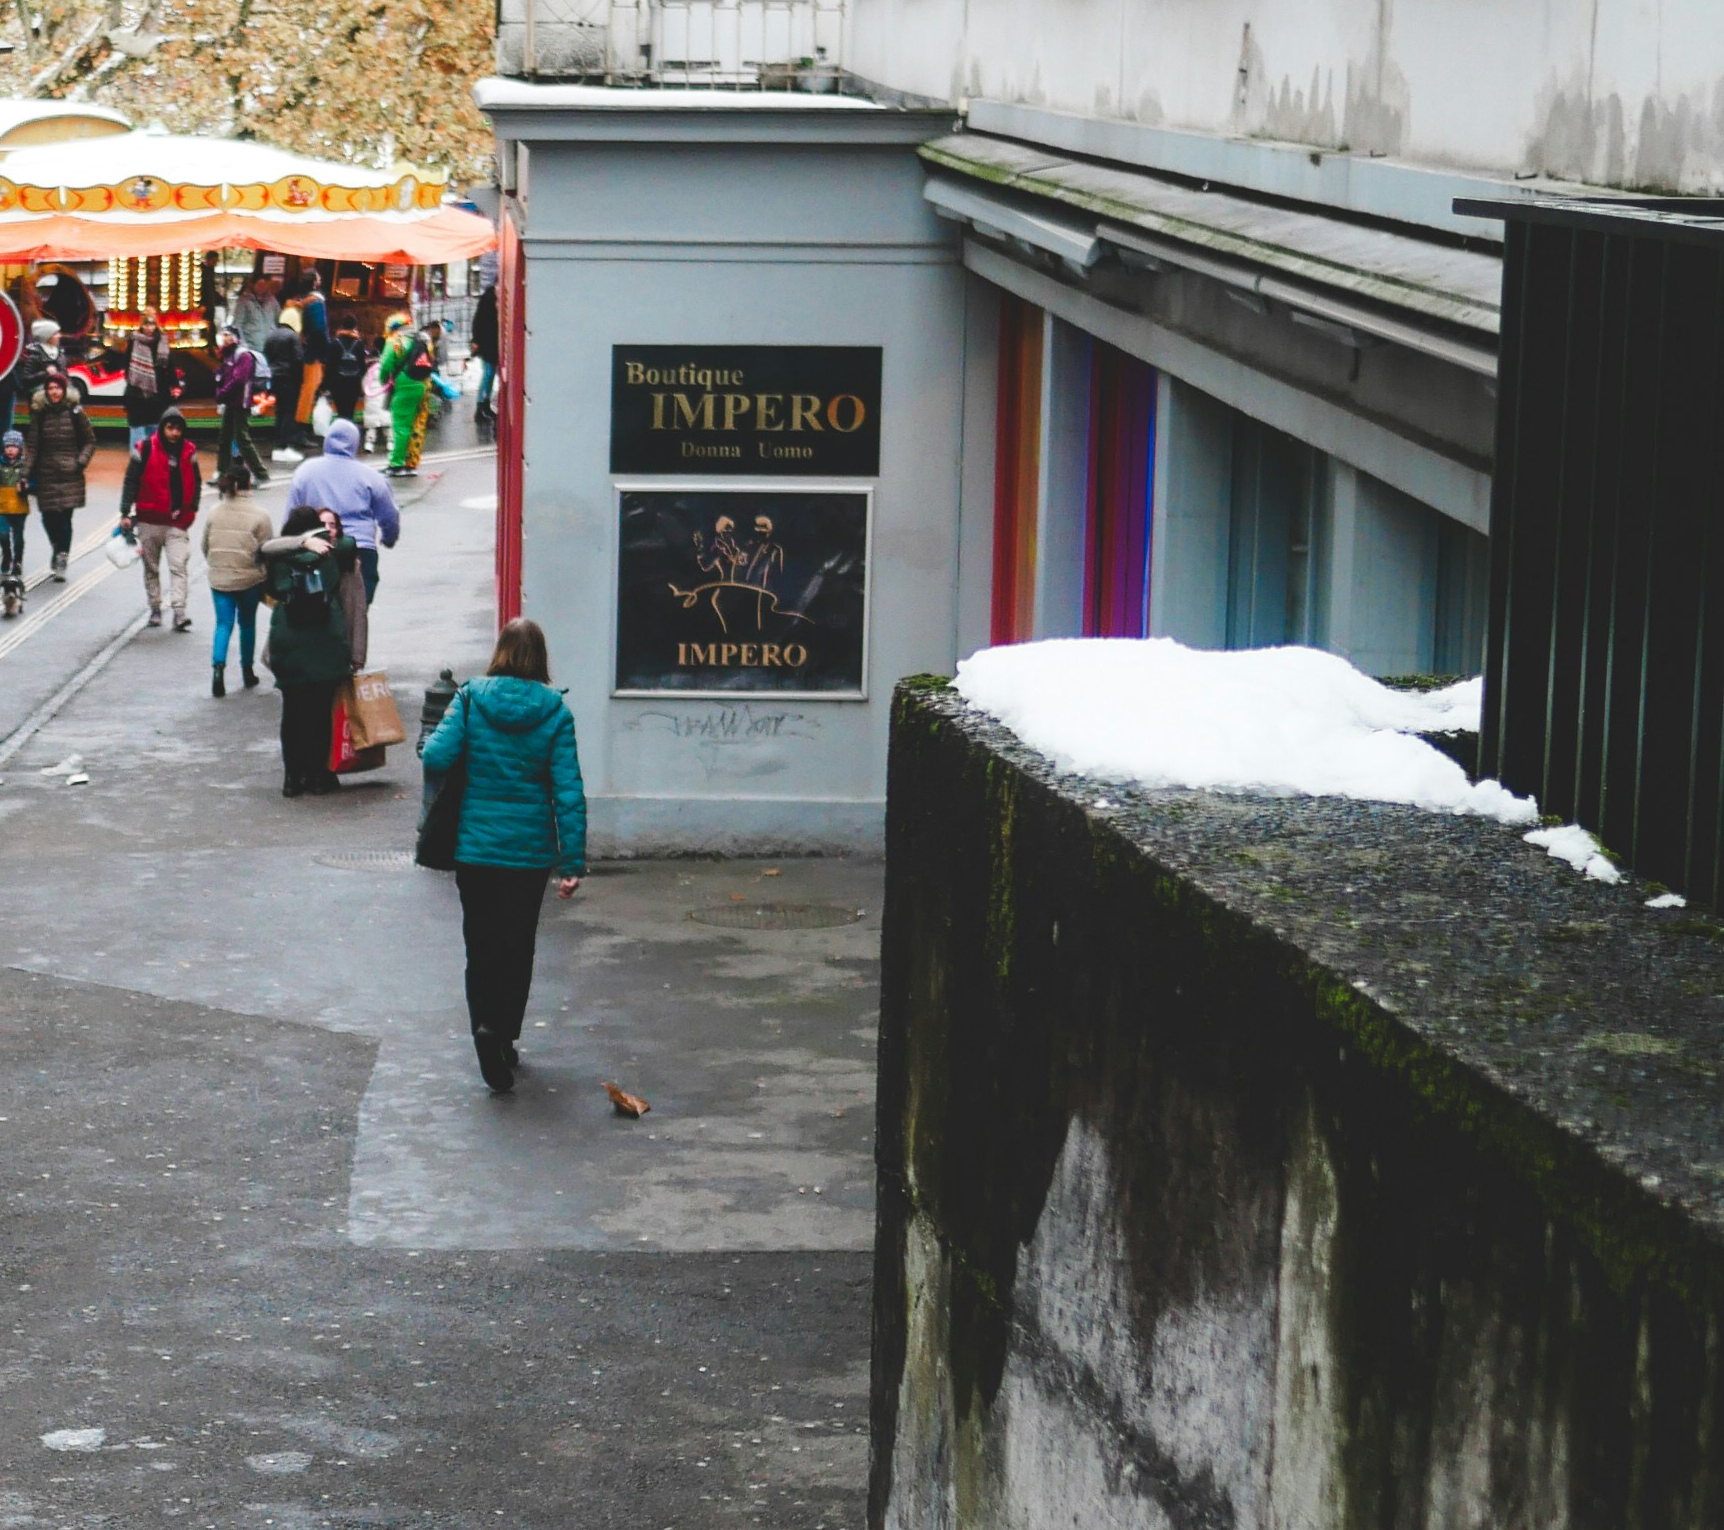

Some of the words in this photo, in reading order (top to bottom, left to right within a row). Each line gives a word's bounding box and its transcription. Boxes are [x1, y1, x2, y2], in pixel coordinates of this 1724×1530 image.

[625, 361, 744, 391] Boutique
[649, 393, 866, 433] IMPERO
[680, 441, 742, 459] Donna
[758, 441, 814, 459] Uomo
[678, 642, 808, 667] IMPERO
